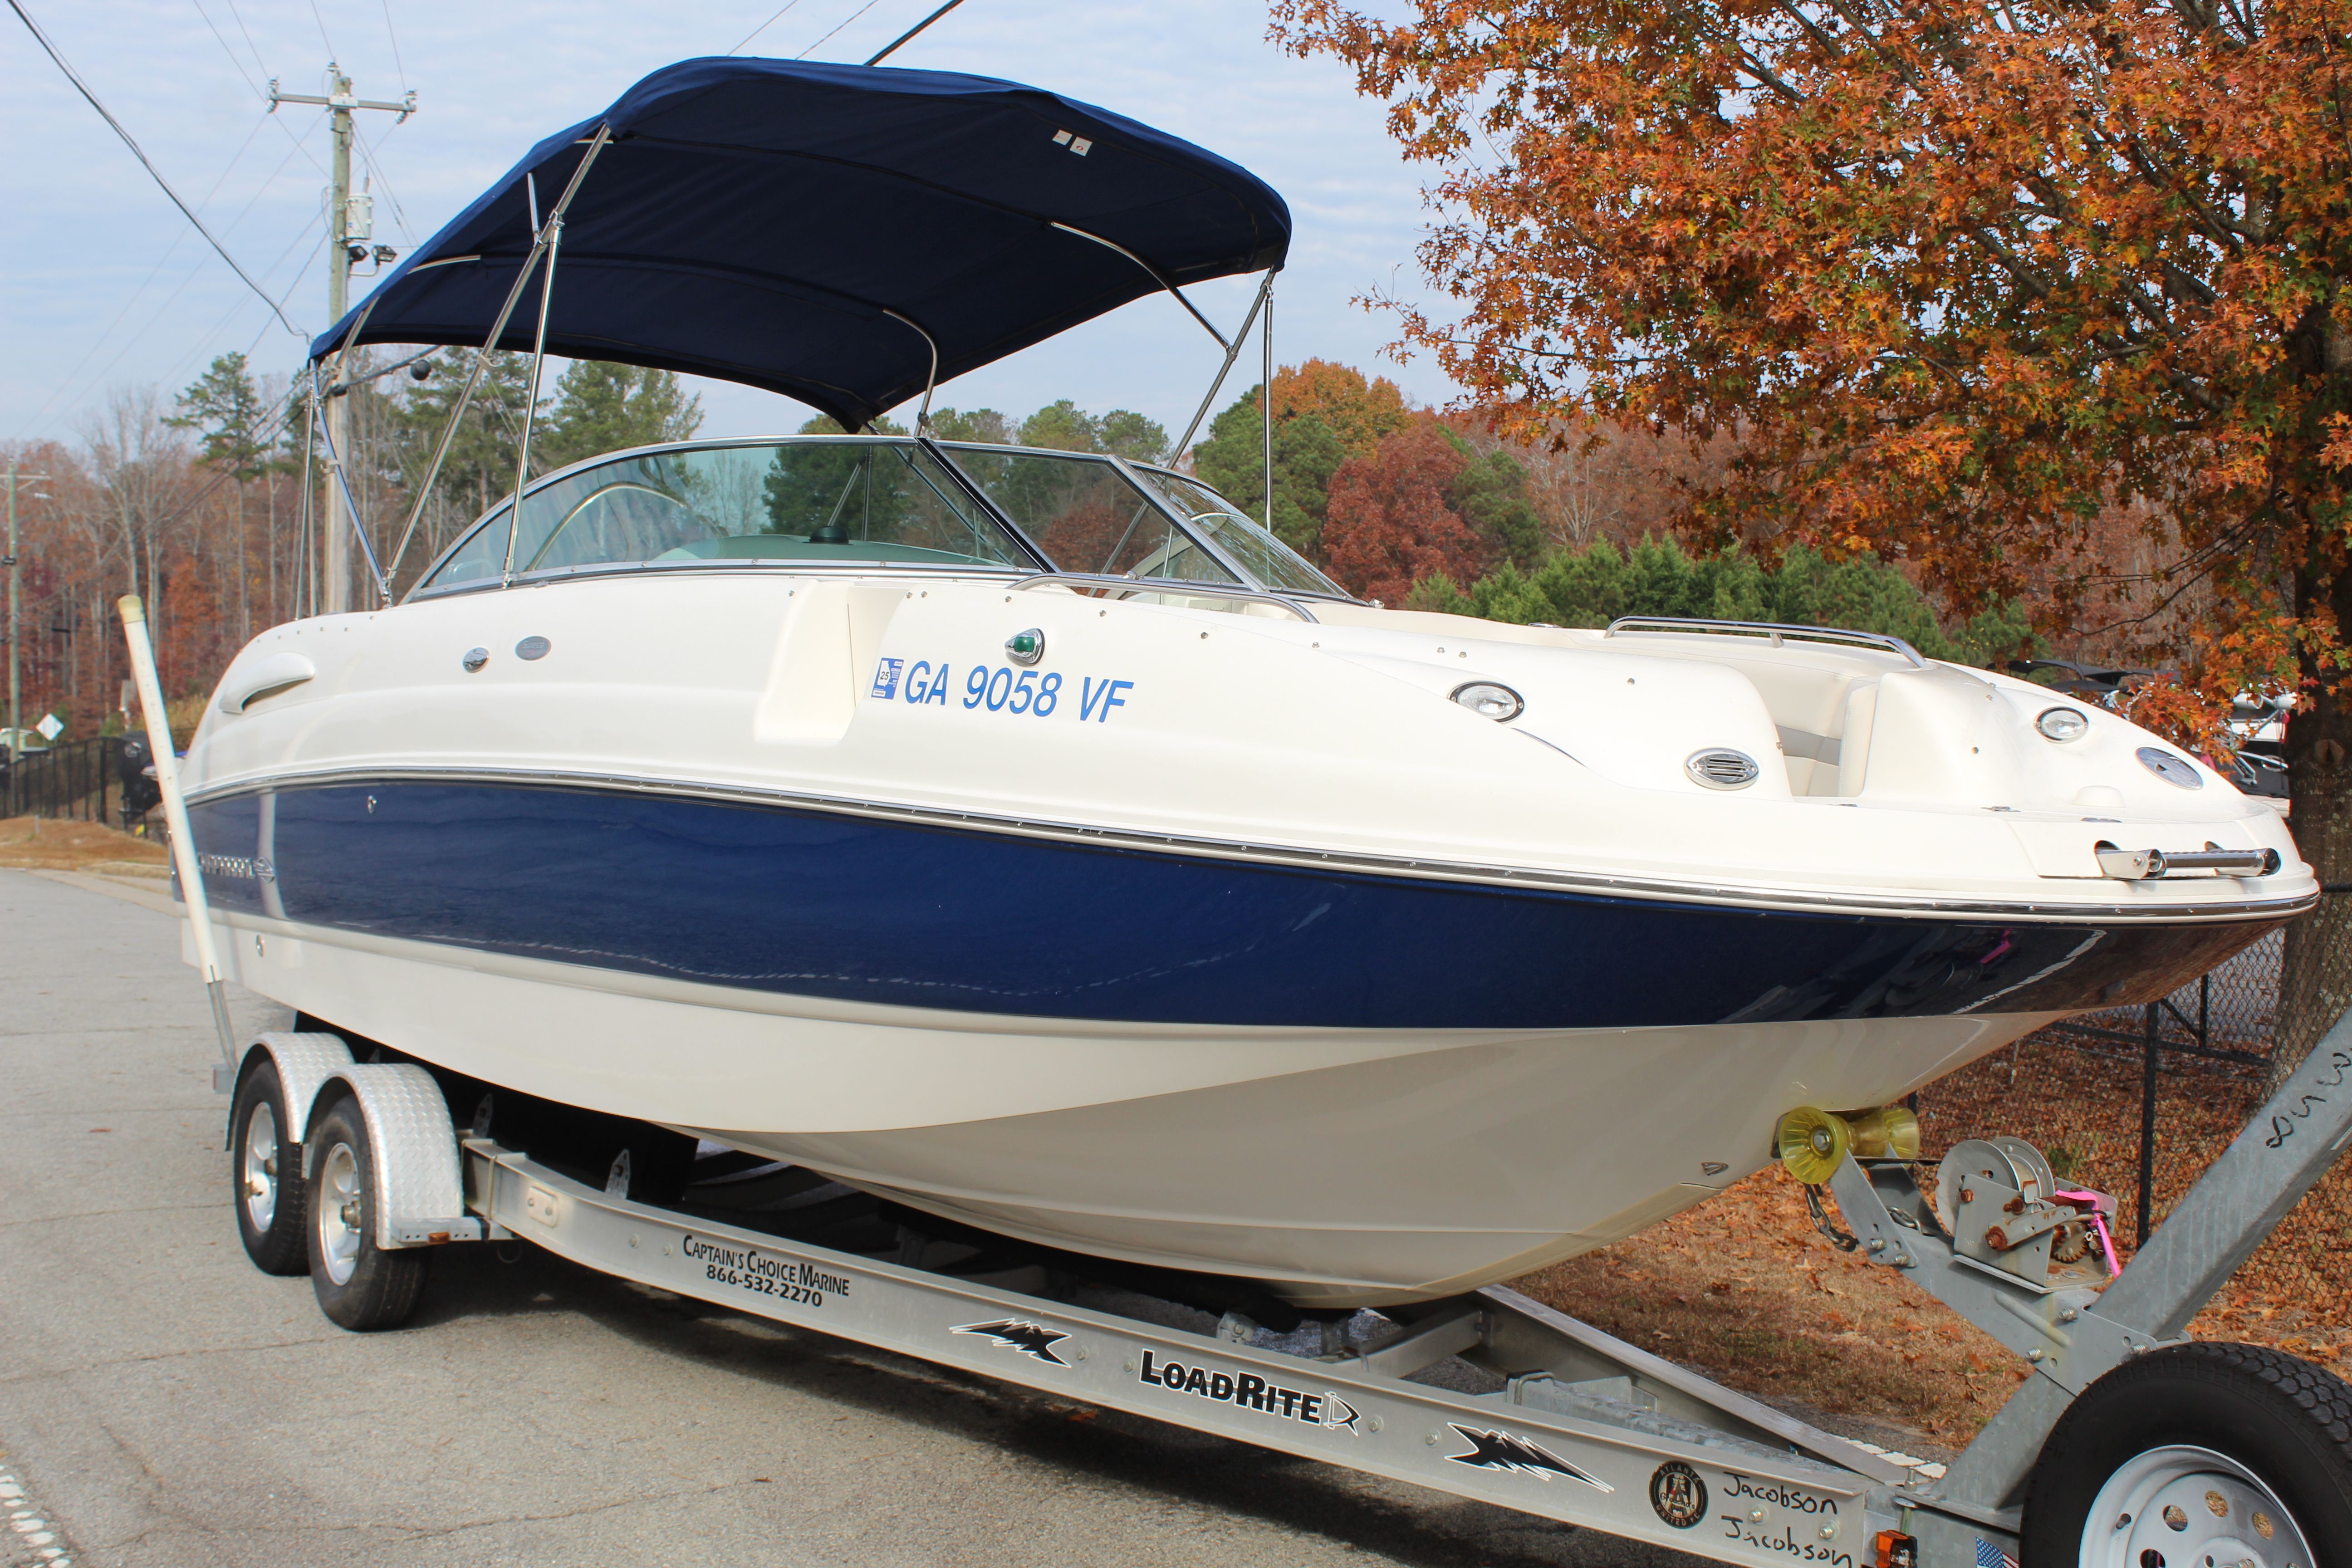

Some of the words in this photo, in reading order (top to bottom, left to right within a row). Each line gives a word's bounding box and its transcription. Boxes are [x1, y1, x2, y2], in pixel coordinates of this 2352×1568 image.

[880, 671, 889, 680] 25
[905, 661, 949, 706] GA
[963, 665, 1063, 717] 9058
[1079, 676, 1134, 723] VF
[683, 1235, 744, 1269] CAPTAIN'S
[747, 1250, 796, 1283] CHOICE
[799, 1263, 850, 1297] MARINE
[706, 1264, 823, 1307] 866-532-2270
[1723, 1471, 1838, 1514] Jacobson
[1656, 1504, 1687, 1526] UNITED
[1690, 1512, 1700, 1524] FC
